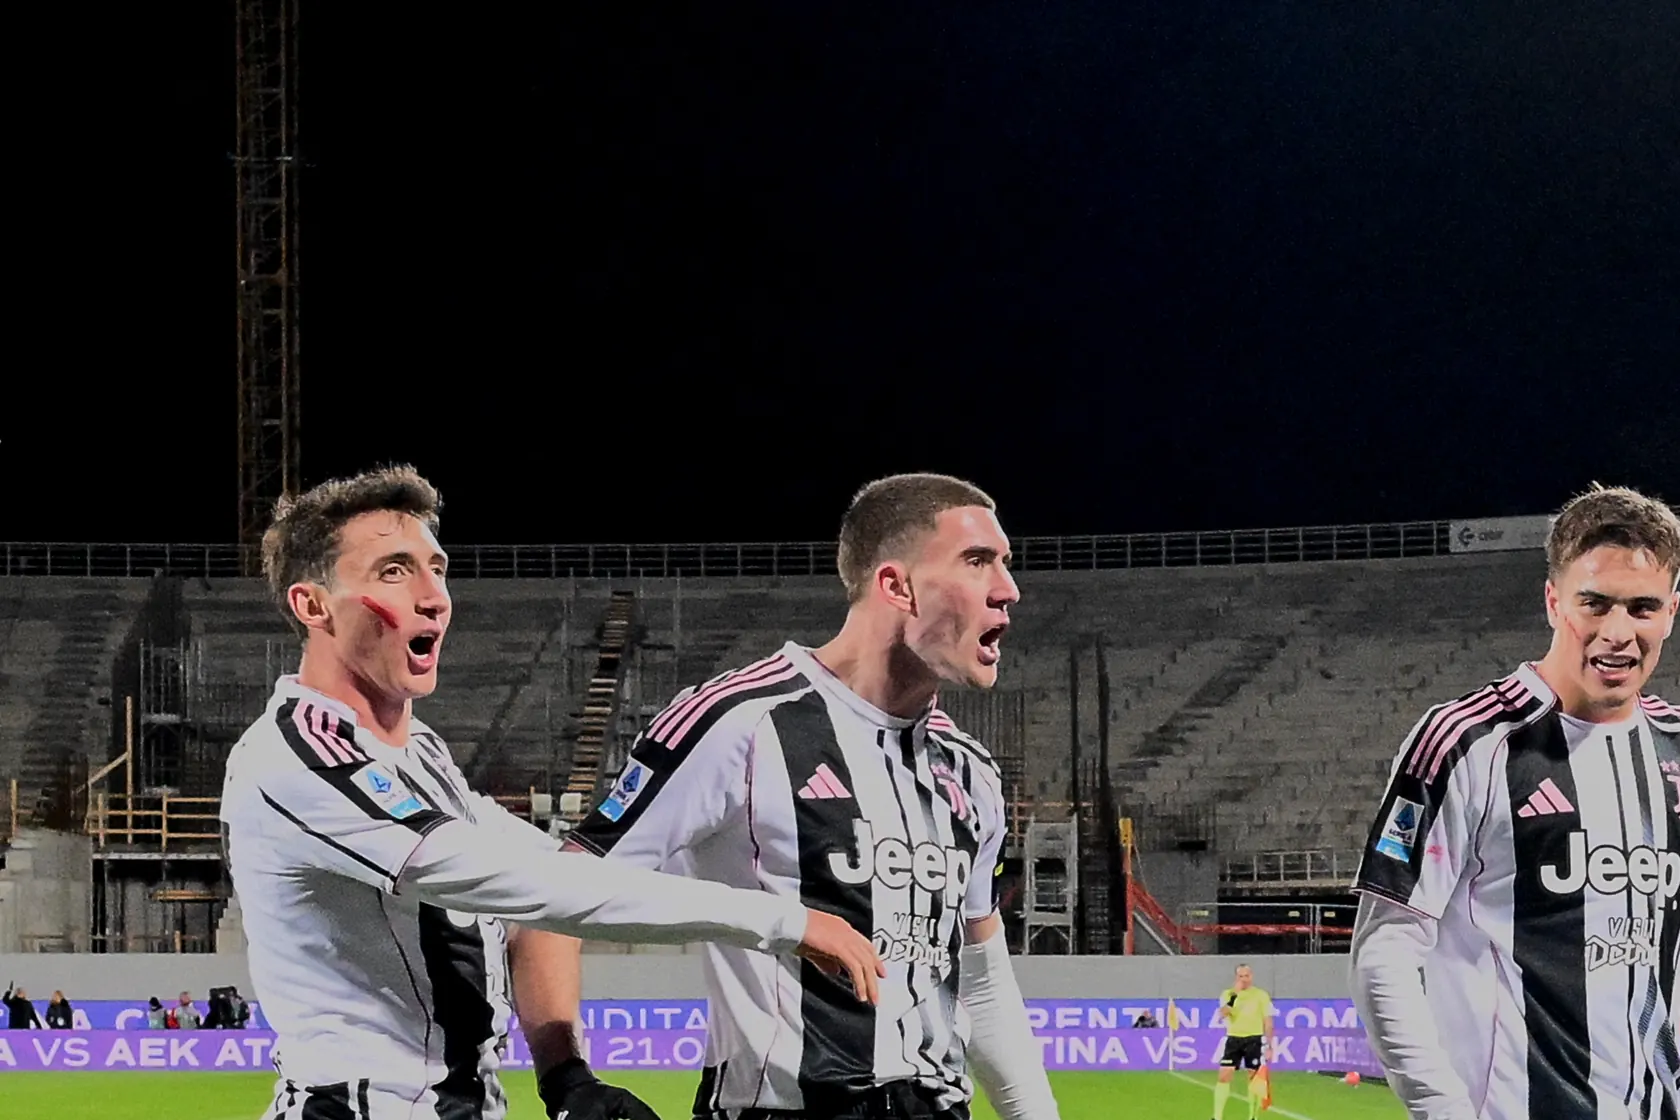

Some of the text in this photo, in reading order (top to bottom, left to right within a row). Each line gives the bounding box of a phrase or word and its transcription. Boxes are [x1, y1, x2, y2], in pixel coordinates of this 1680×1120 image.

[828, 817, 970, 909] Jeep
[32, 1037, 91, 1067] VS
[104, 1037, 200, 1068] AEK
[606, 1036, 703, 1066] 21.0
[1142, 1036, 1198, 1065] VS
